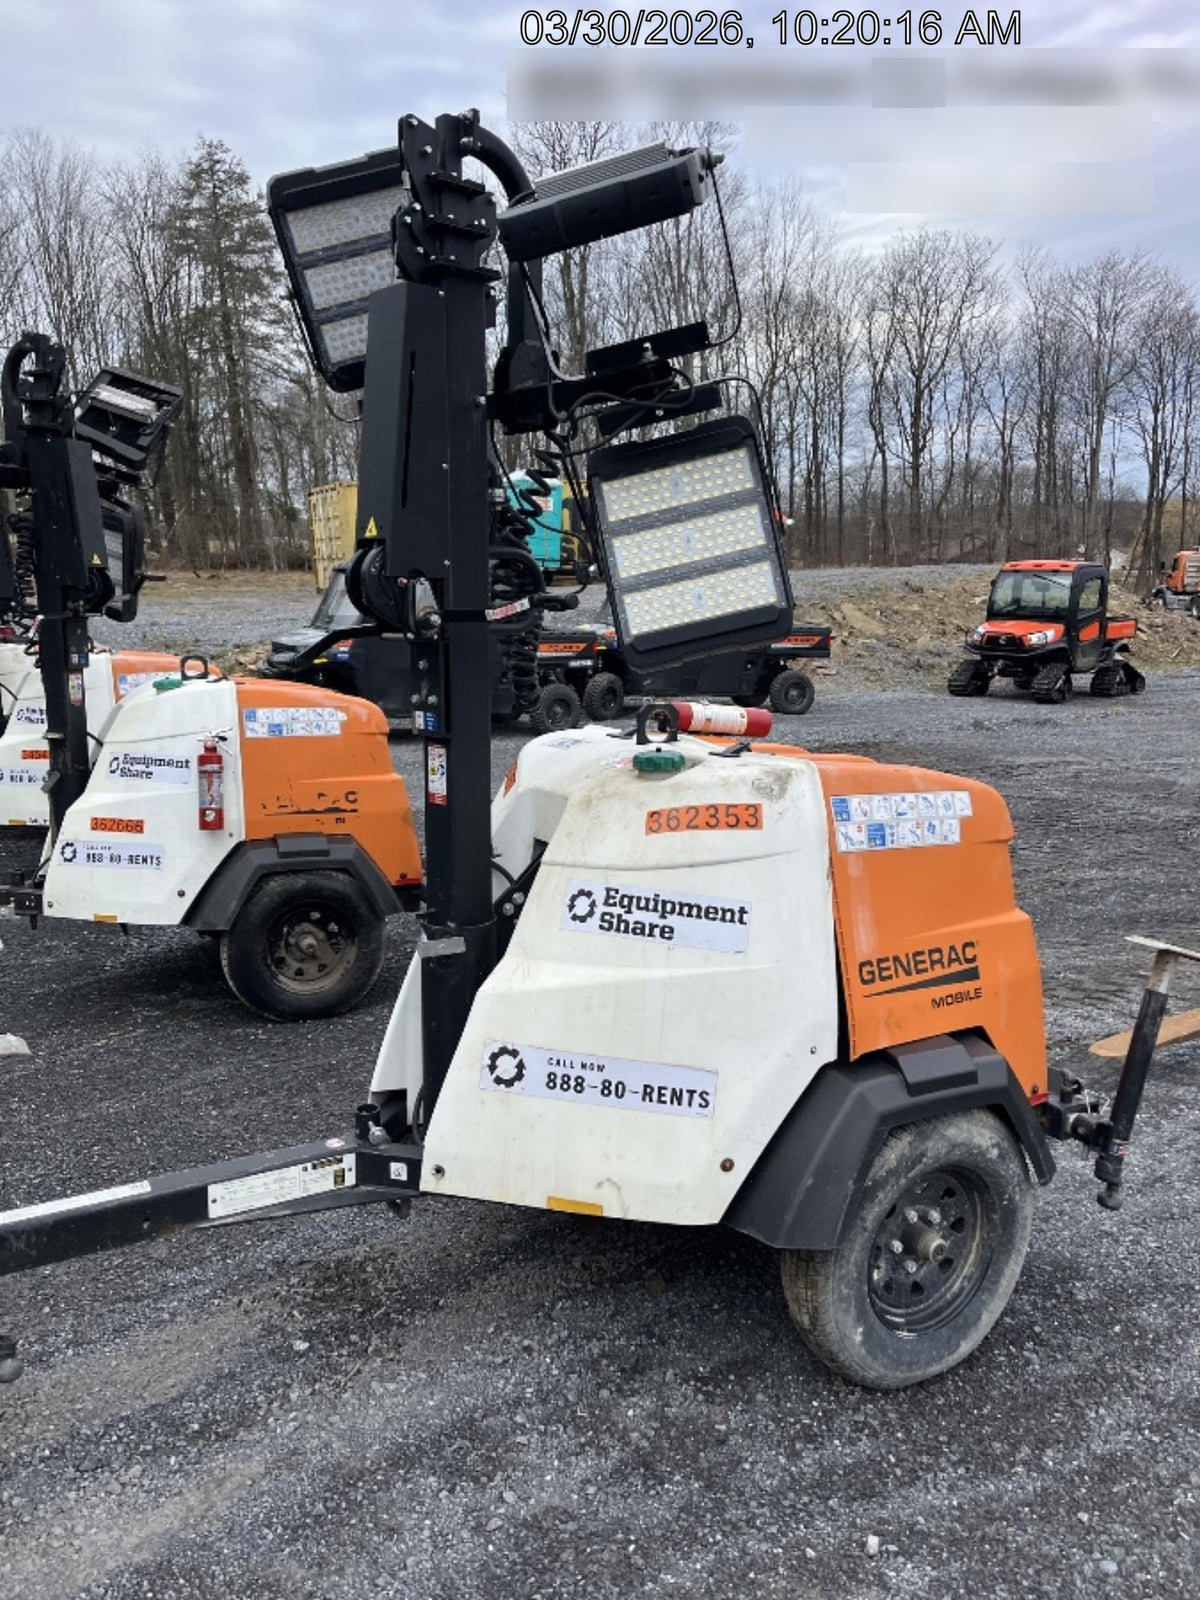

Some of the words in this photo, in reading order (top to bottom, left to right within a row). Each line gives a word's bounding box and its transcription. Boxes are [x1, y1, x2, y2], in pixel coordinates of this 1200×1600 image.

[119, 766, 154, 779] Share
[121, 753, 191, 770] Equipment
[91, 818, 144, 832] 362666
[649, 804, 760, 833] 362353
[602, 887, 749, 926] Equipment
[598, 911, 675, 941] Share
[858, 941, 978, 986] GENERAC
[931, 987, 983, 1009] MOBILE
[546, 1057, 575, 1070] CALL
[580, 1062, 606, 1073] NOW
[545, 1071, 711, 1109] 888-80-RENTS
